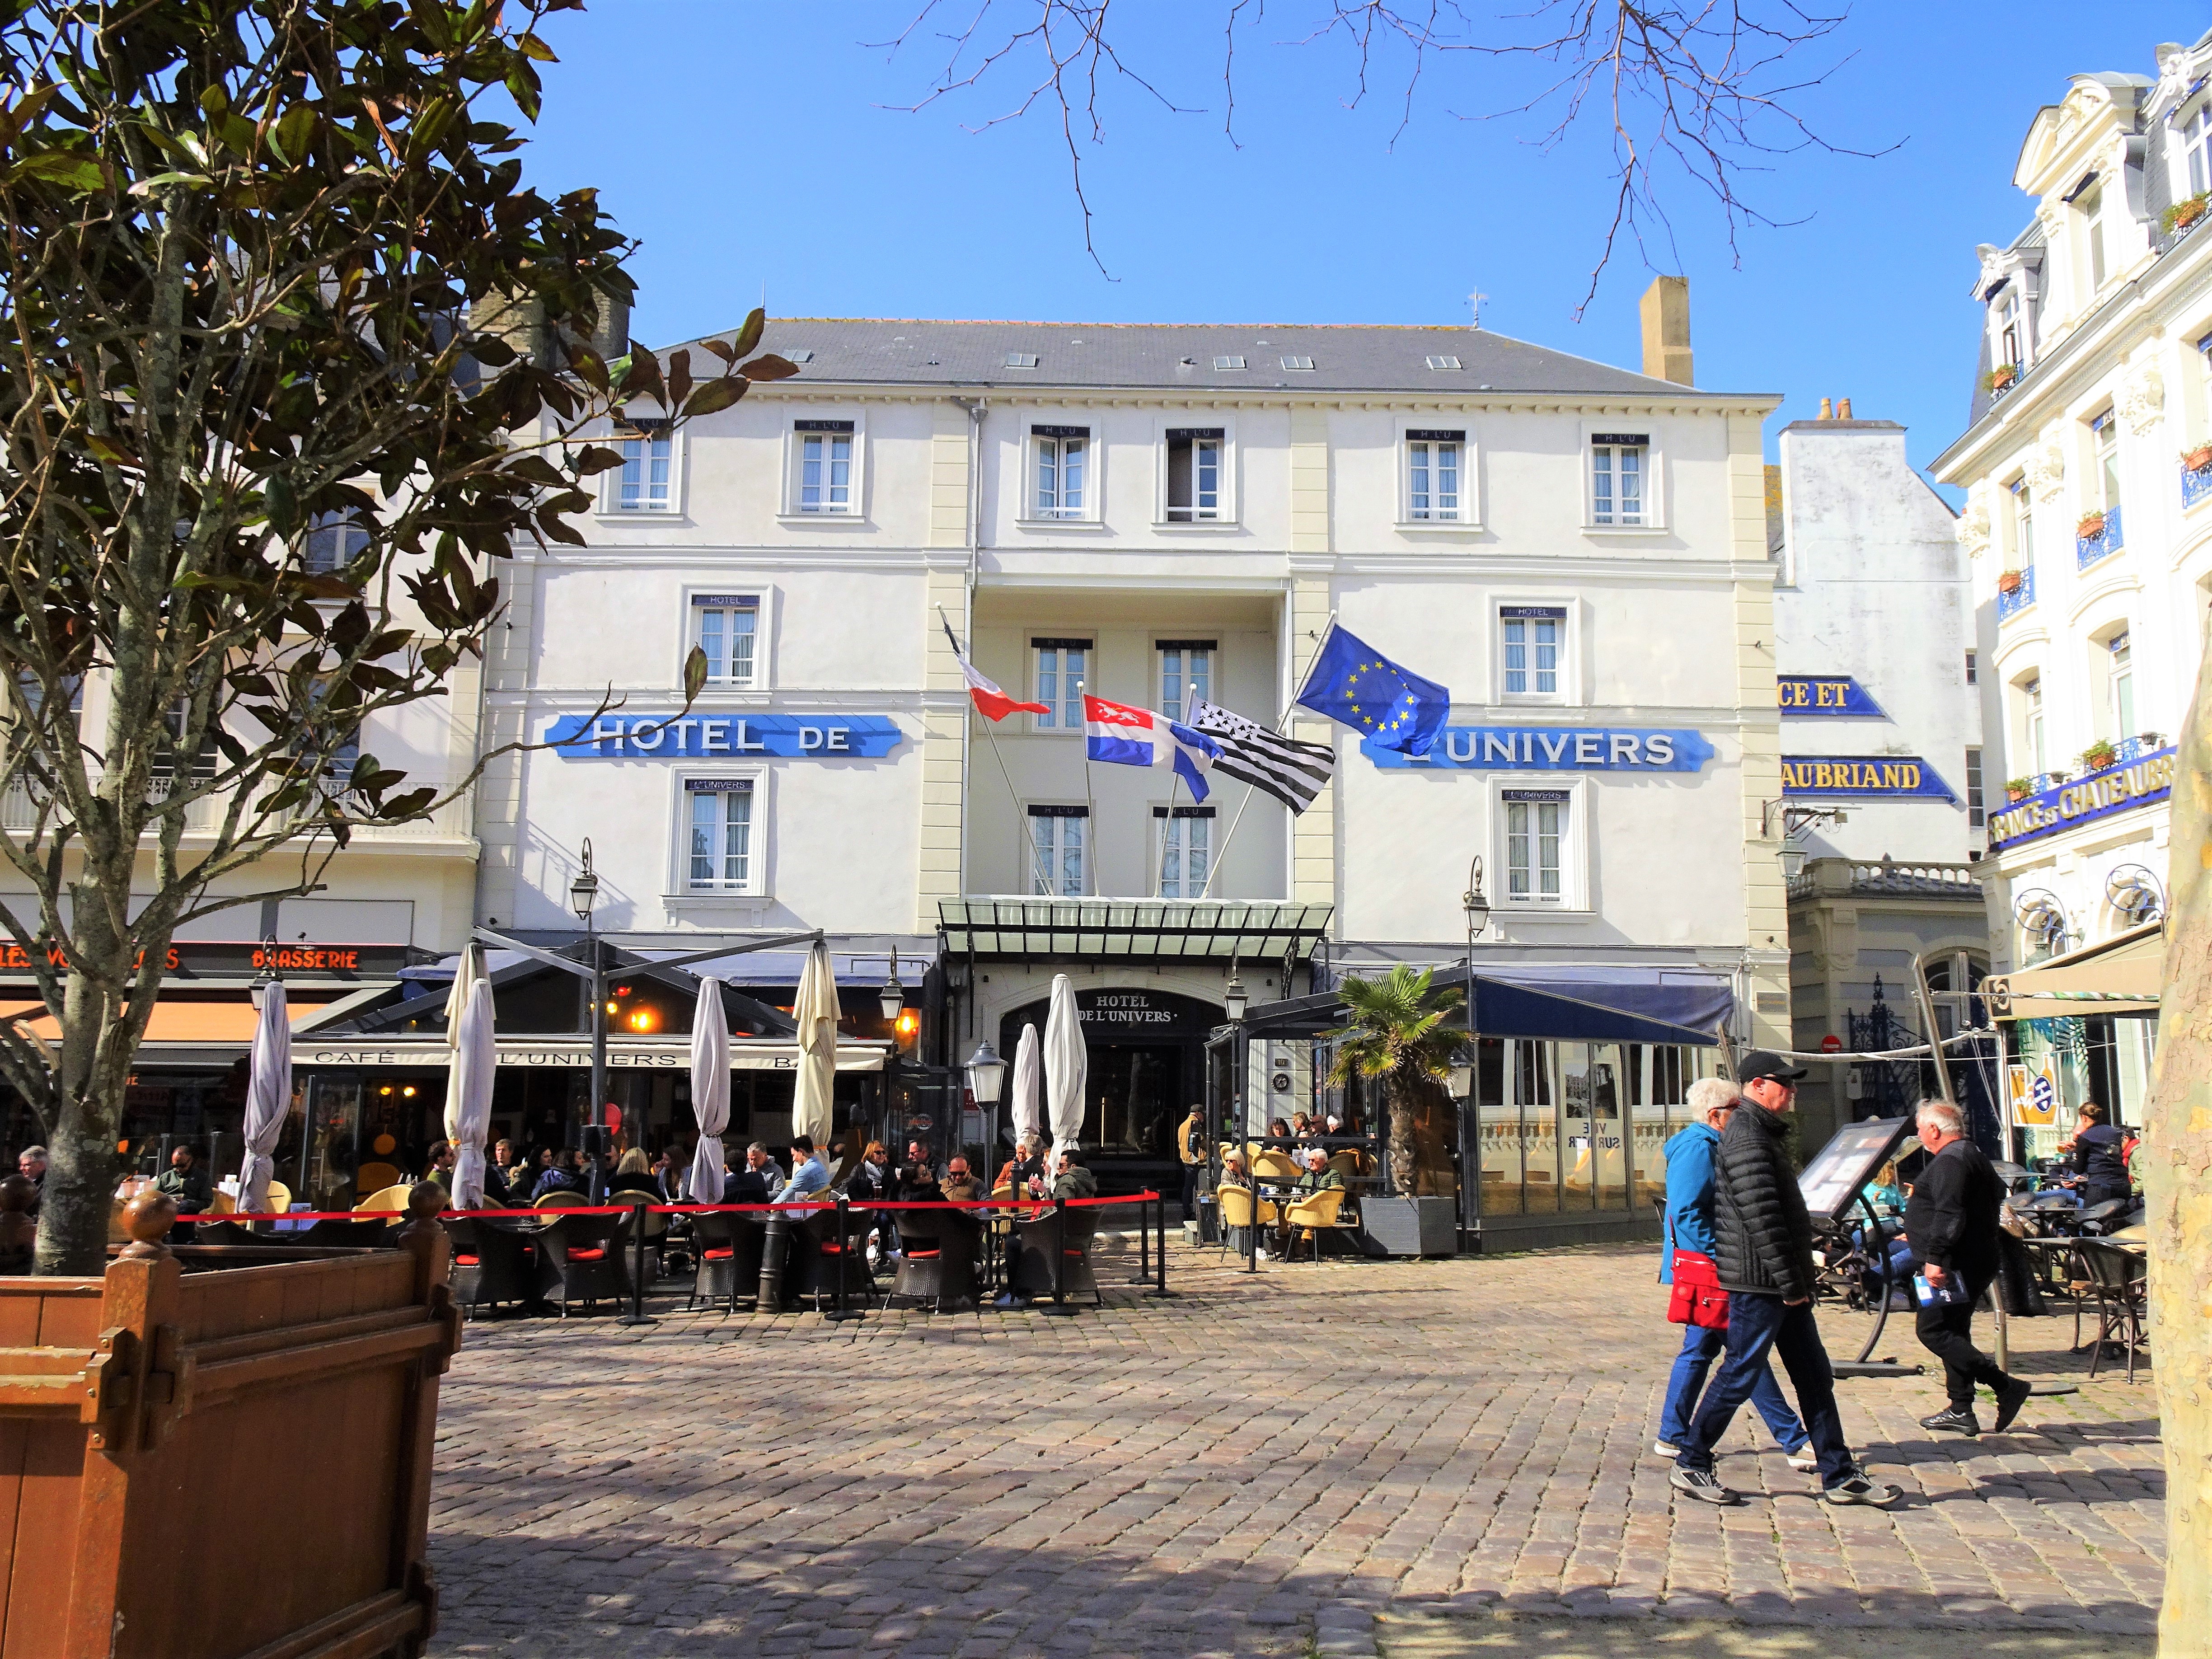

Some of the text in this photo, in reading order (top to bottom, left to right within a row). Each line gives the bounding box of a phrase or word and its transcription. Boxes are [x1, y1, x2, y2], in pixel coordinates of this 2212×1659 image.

[711, 596, 741, 604] HOTEL
[1518, 607, 1548, 616] HOTEL
[1777, 682, 1850, 707] CE ET
[592, 719, 850, 750] HOTEL DE
[1781, 764, 1921, 789] AUBRIAND
[694, 781, 745, 789] L'UNIVERS
[1097, 995, 1149, 1008] HOTEL
[1078, 1010, 1171, 1022] DE L'UNIVERS
[316, 1050, 798, 1068] CAFÉ L'UNIERS B
